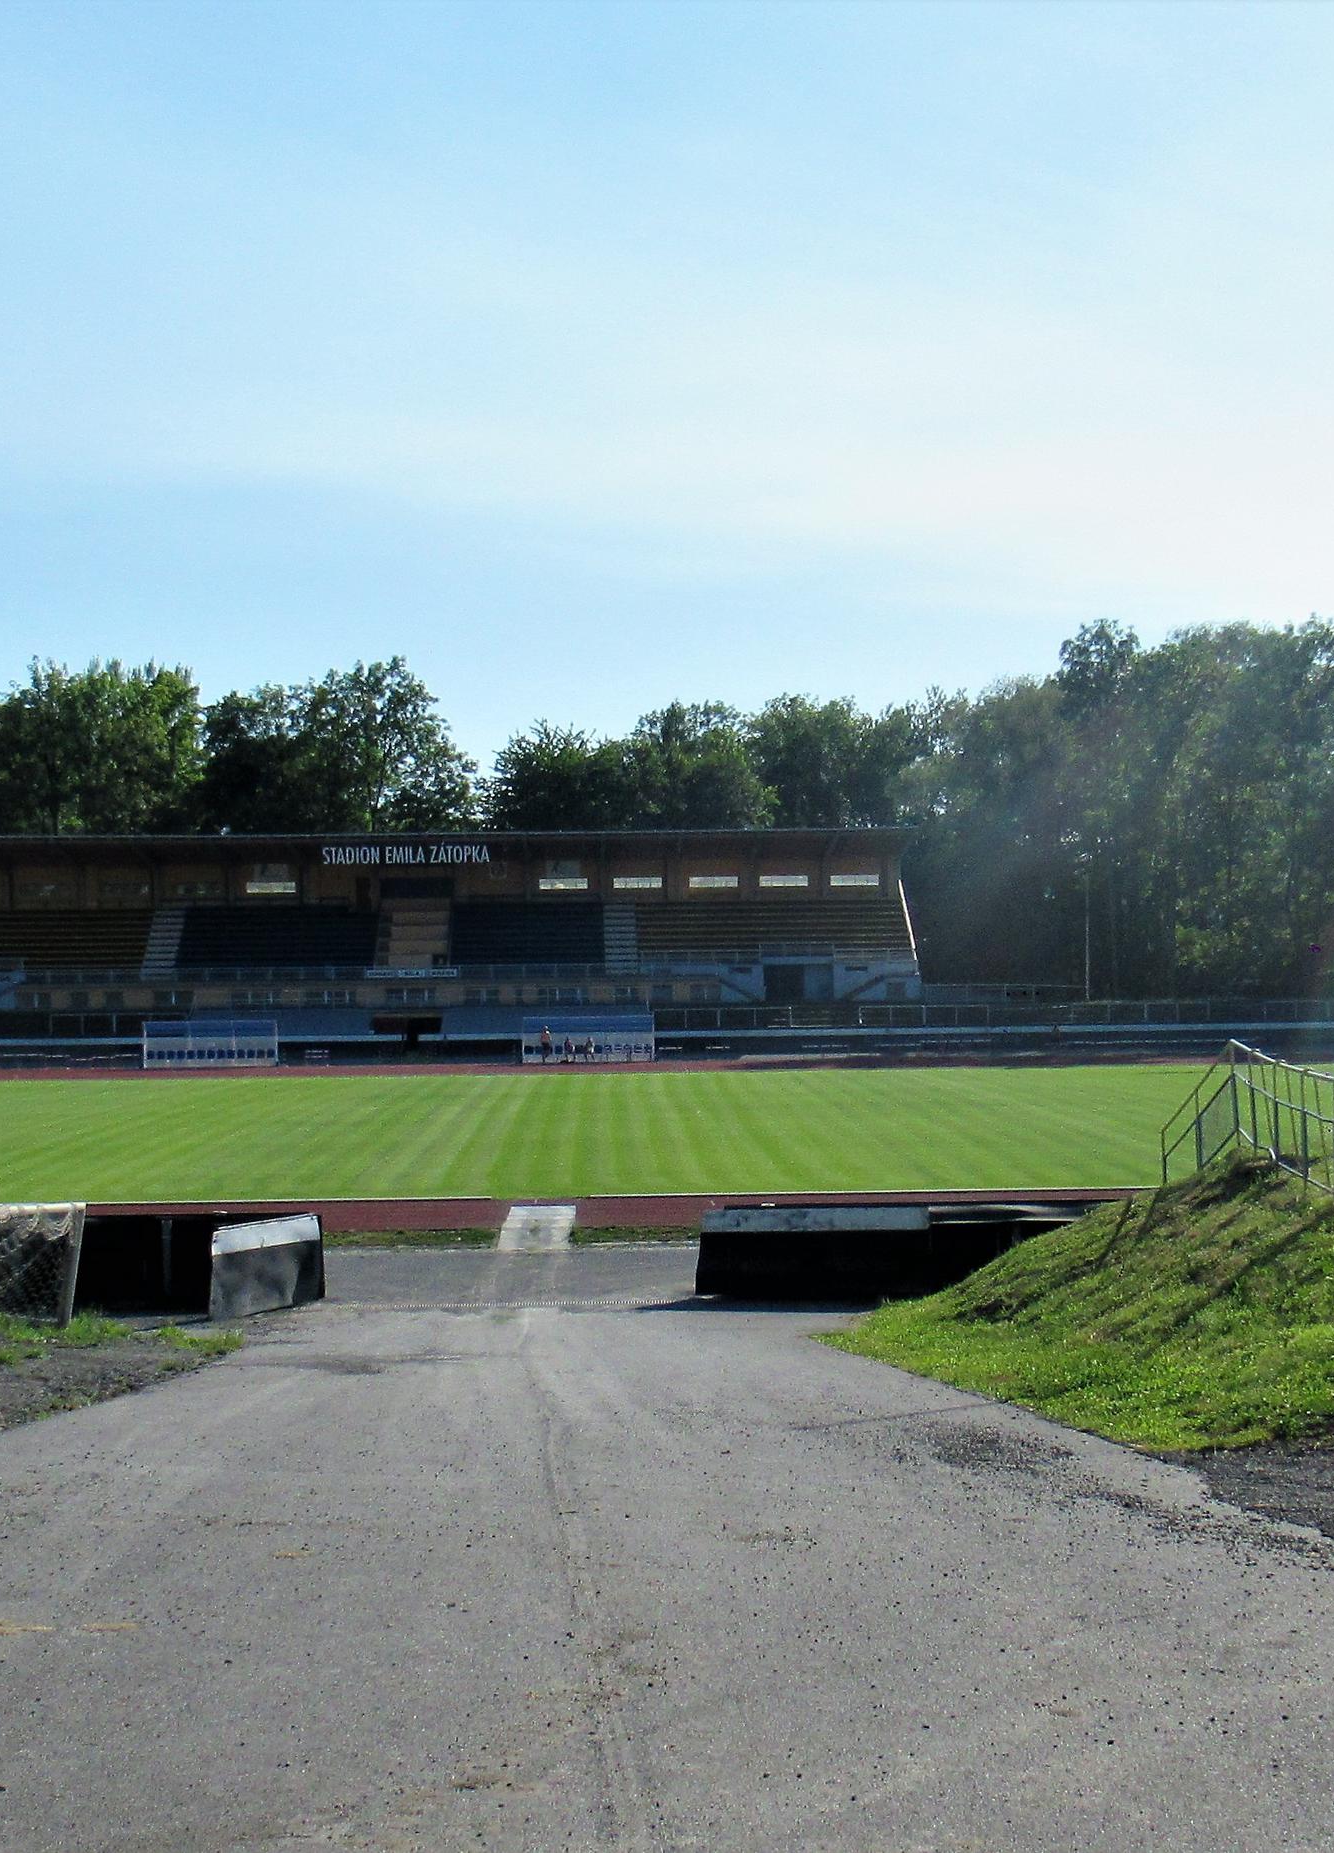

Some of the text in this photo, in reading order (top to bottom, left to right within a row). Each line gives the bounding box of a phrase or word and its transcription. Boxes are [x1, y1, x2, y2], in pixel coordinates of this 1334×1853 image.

[322, 843, 490, 865] STADION EMILA ZÁTOPKA
